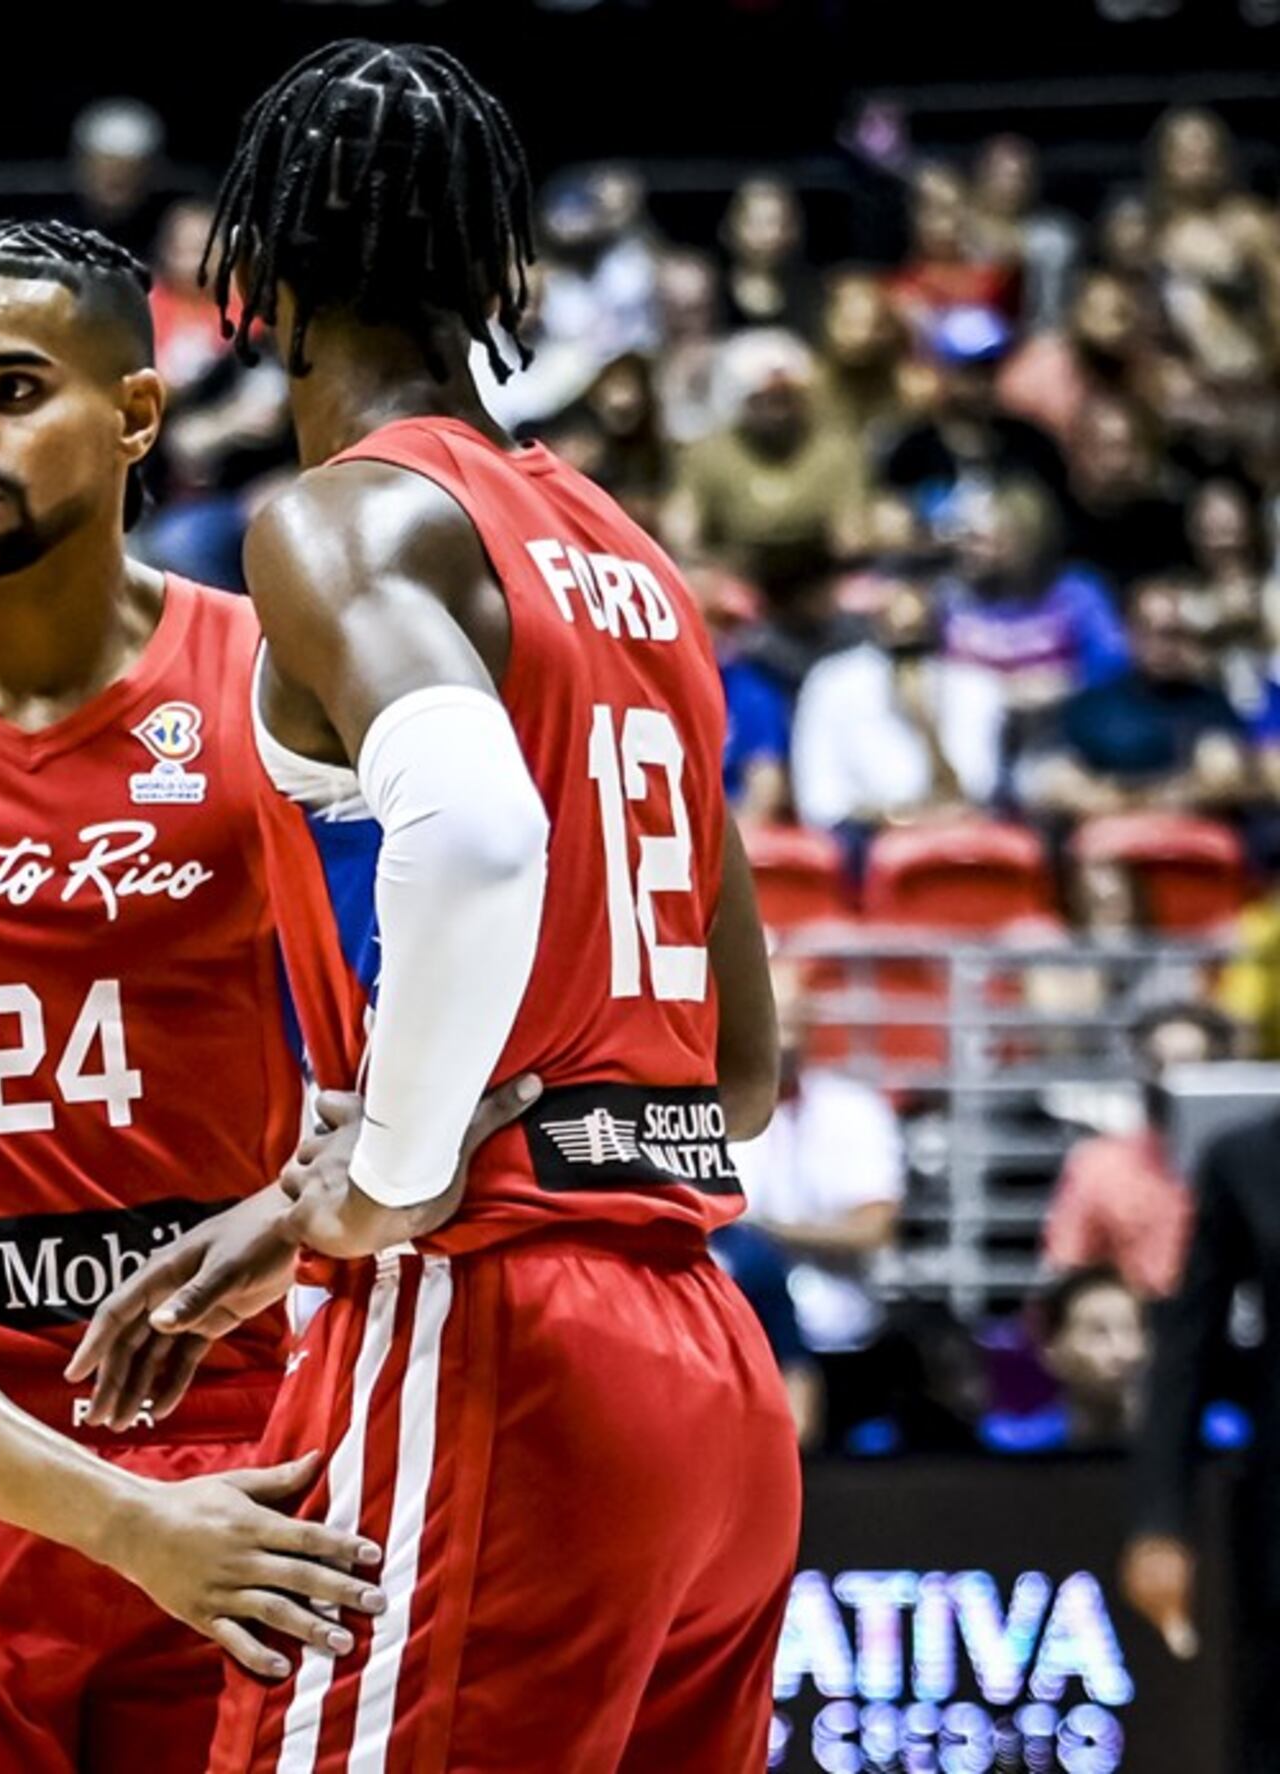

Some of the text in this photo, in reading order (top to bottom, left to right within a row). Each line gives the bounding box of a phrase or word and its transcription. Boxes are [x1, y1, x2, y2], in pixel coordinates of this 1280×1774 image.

[525, 539, 679, 641] FORD
[61, 820, 214, 921] Rico
[588, 704, 708, 1003] 12
